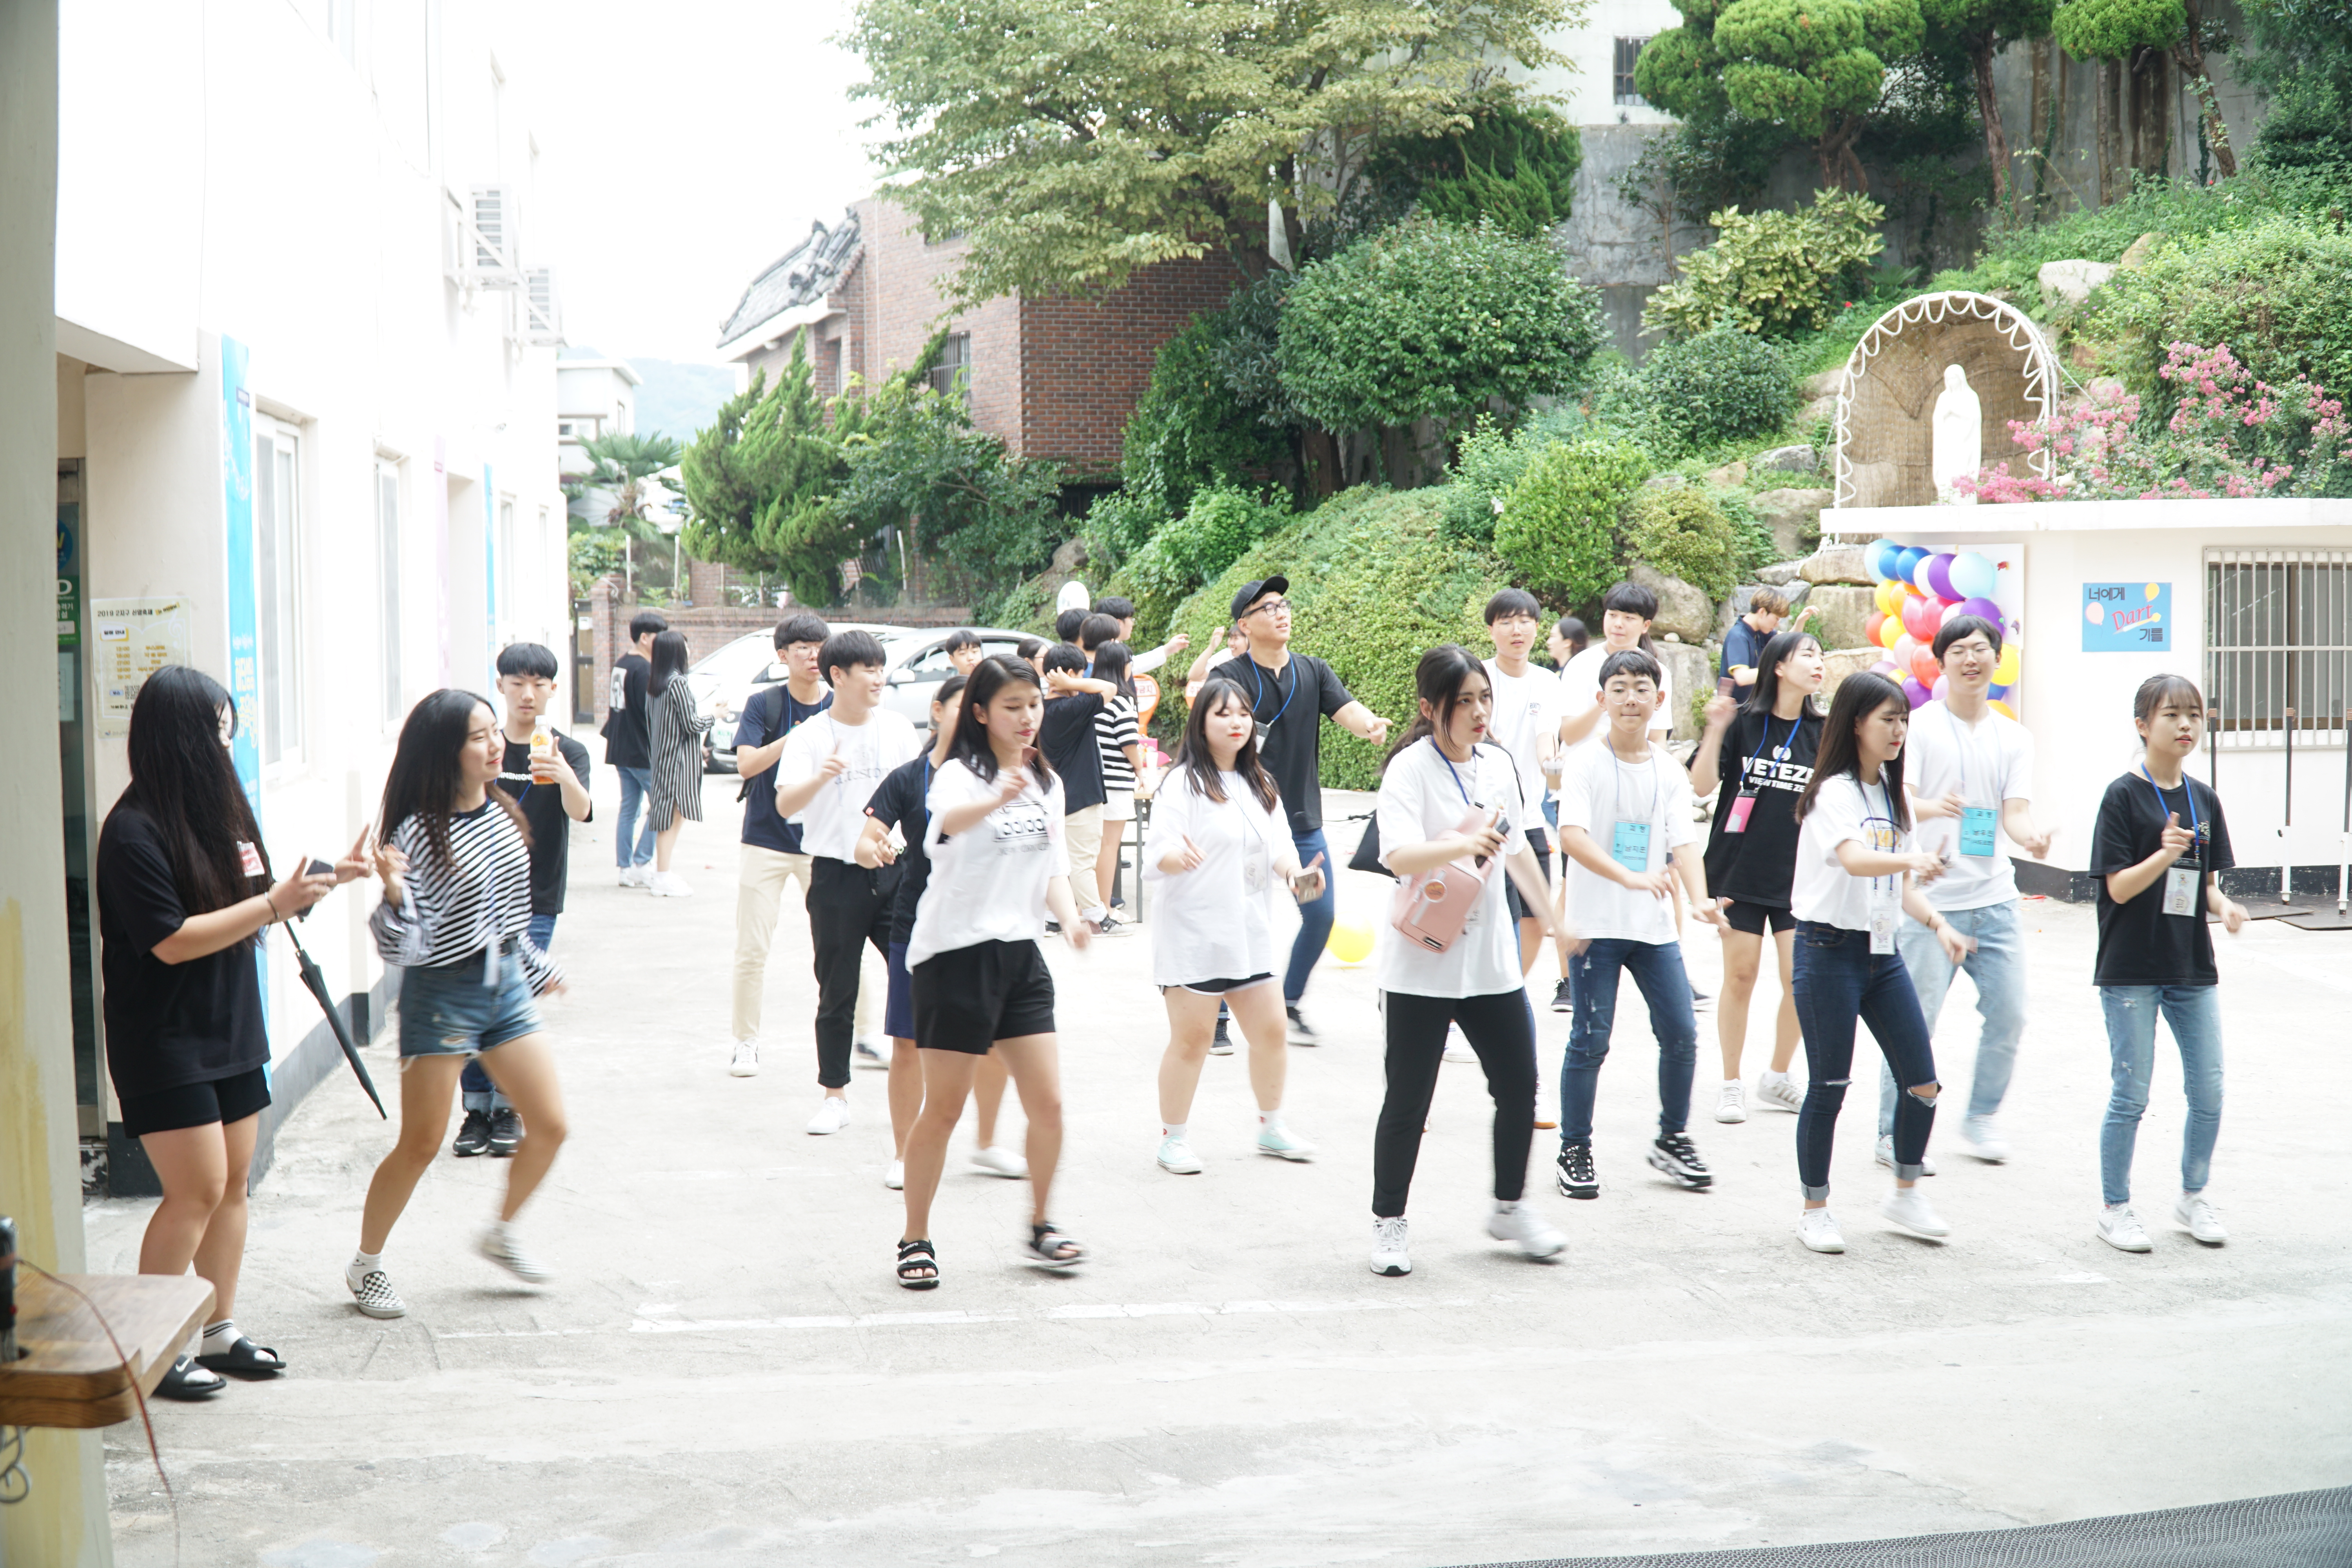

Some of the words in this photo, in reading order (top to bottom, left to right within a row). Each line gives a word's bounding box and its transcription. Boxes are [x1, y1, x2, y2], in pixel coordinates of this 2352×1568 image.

[2089, 587, 2125, 601] 너에게
[2112, 604, 2153, 630] Dart
[2140, 628, 2163, 642] 기를
[1136, 685, 1153, 695] 금지
[1749, 776, 1771, 786] VIEW
[1771, 780, 1793, 791] TIME
